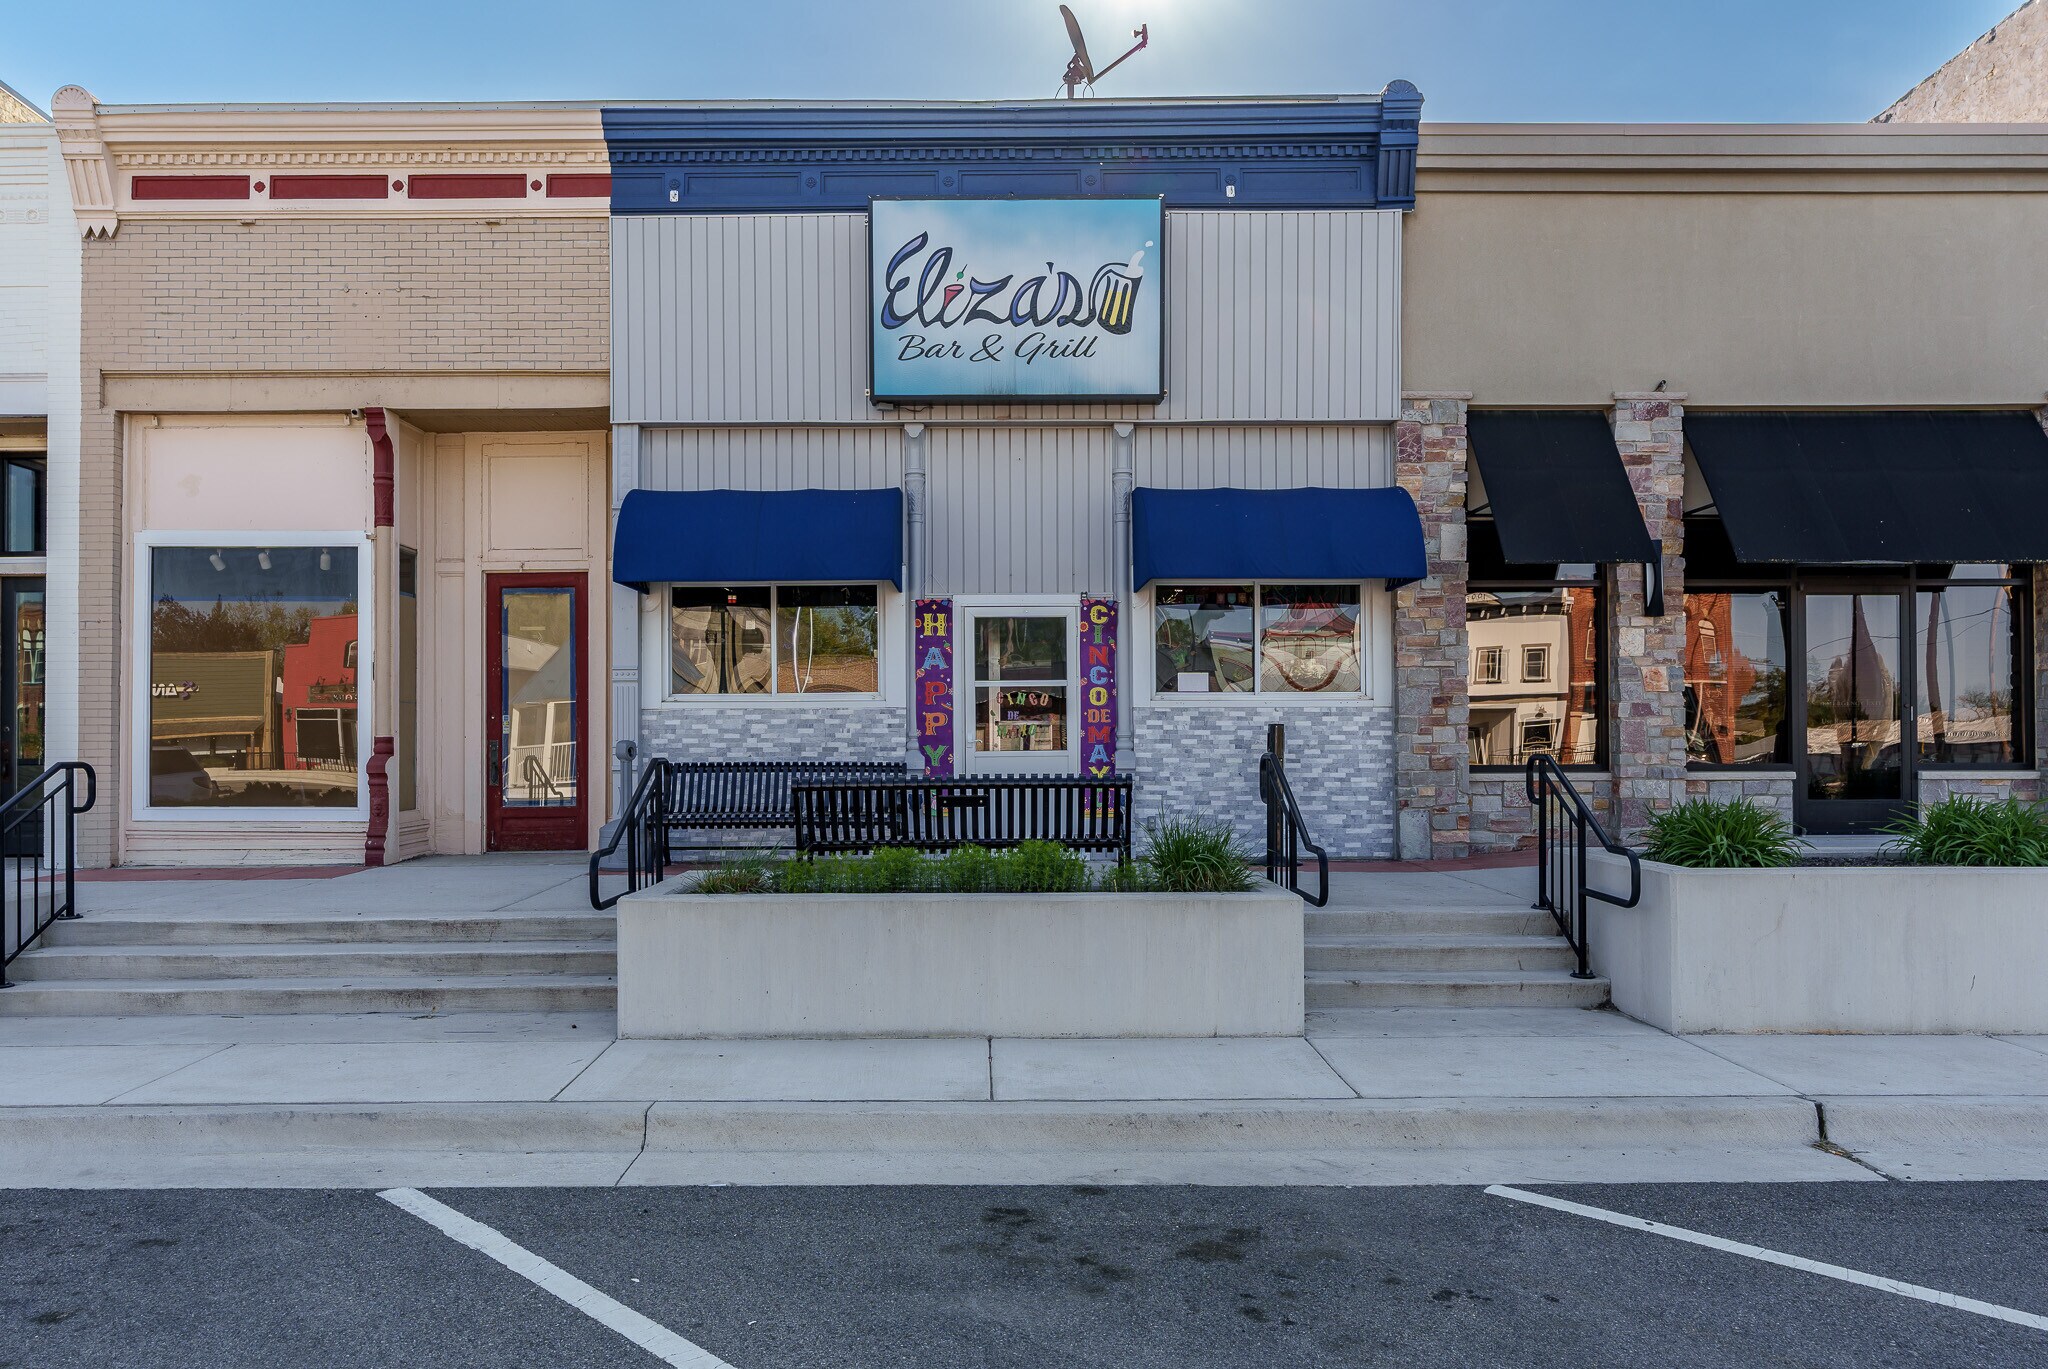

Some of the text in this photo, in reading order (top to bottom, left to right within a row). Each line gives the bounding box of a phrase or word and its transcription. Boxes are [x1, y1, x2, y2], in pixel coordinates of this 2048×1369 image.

[880, 230, 1096, 330] Eliza's
[897, 332, 1099, 365] Bar & Grill
[1088, 604, 1110, 707] CINCO
[922, 613, 949, 767] HAPPY
[996, 691, 1049, 707] CINCO
[1007, 710, 1020, 721] DE
[1087, 708, 1111, 723] DE
[997, 723, 1038, 738] MAYO
